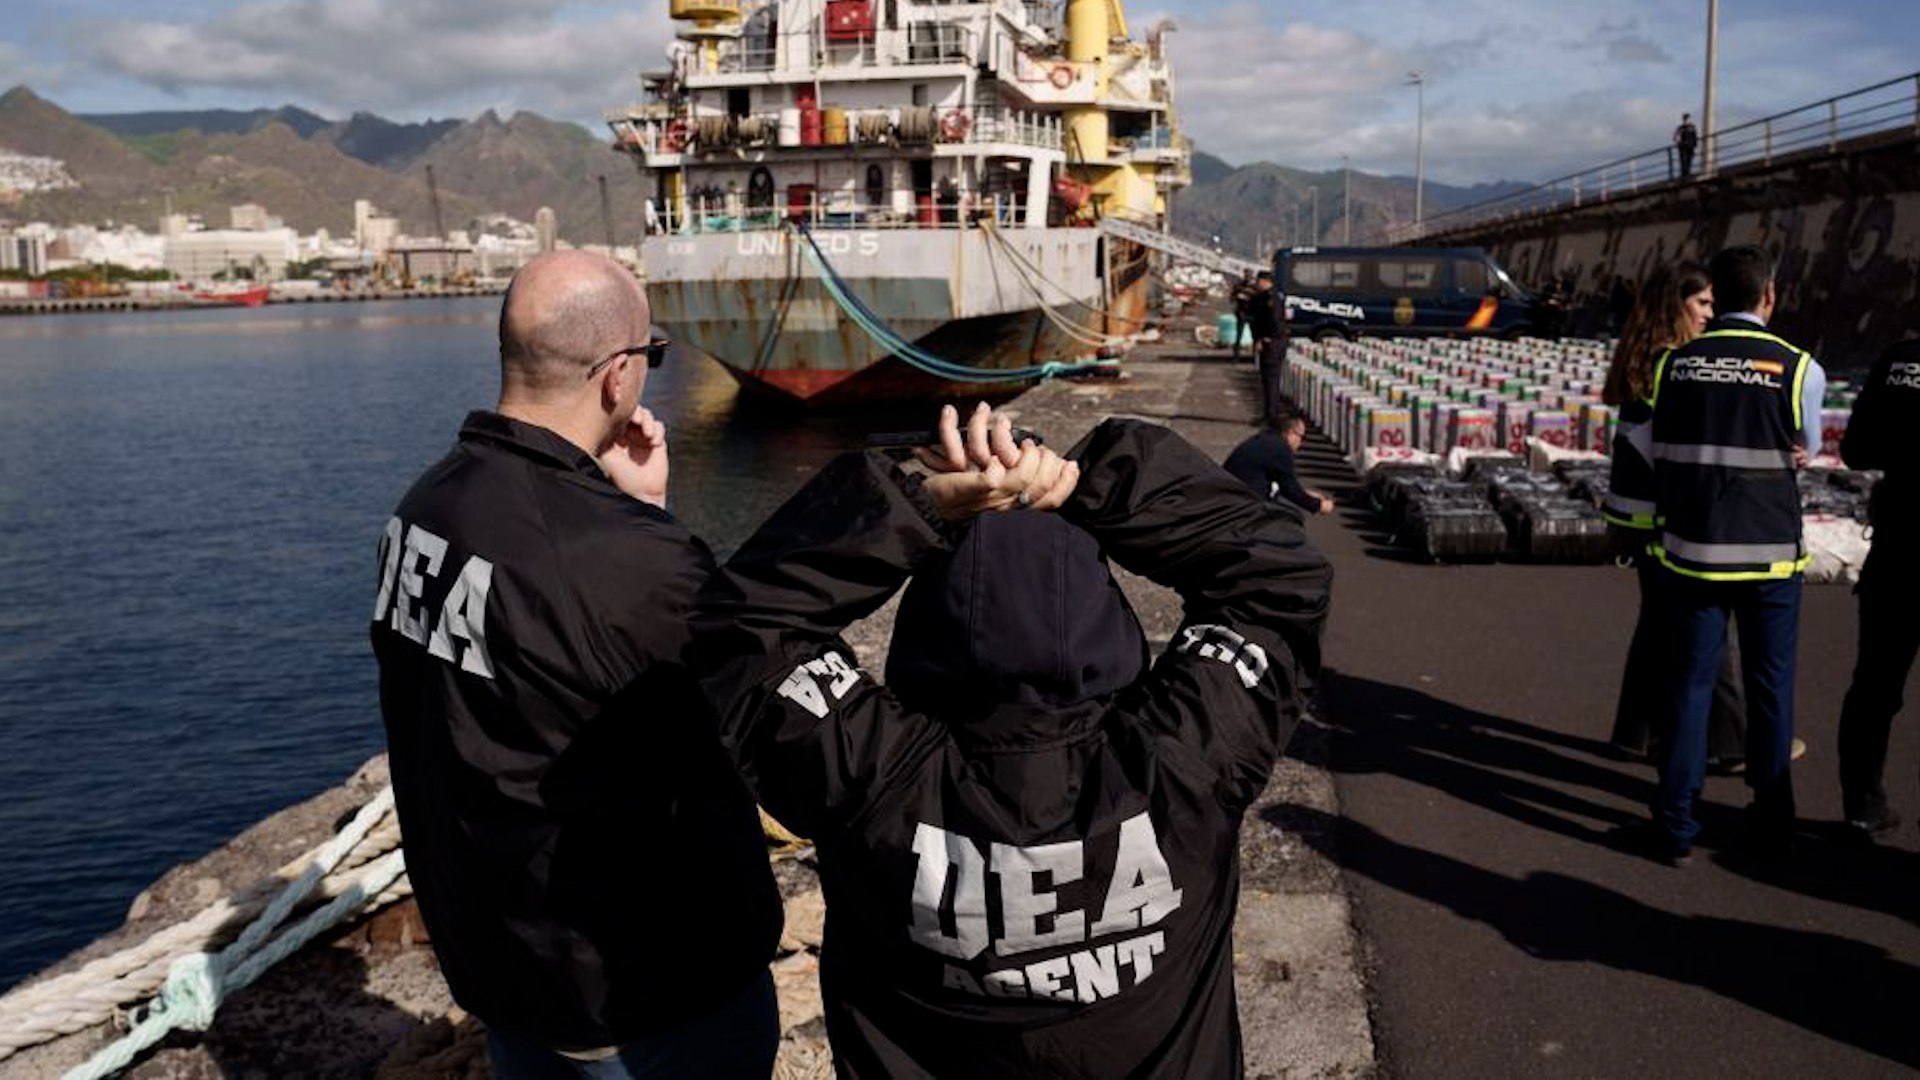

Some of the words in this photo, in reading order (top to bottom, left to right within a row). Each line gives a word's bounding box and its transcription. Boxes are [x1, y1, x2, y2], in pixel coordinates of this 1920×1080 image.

[737, 232, 850, 255] UNIED
[1285, 295, 1365, 320] POLICIA
[1673, 356, 1754, 371] POLICIA
[1670, 368, 1782, 388] NACIONAL
[908, 811, 1183, 961] DEA
[943, 931, 1165, 1005] AGENT
